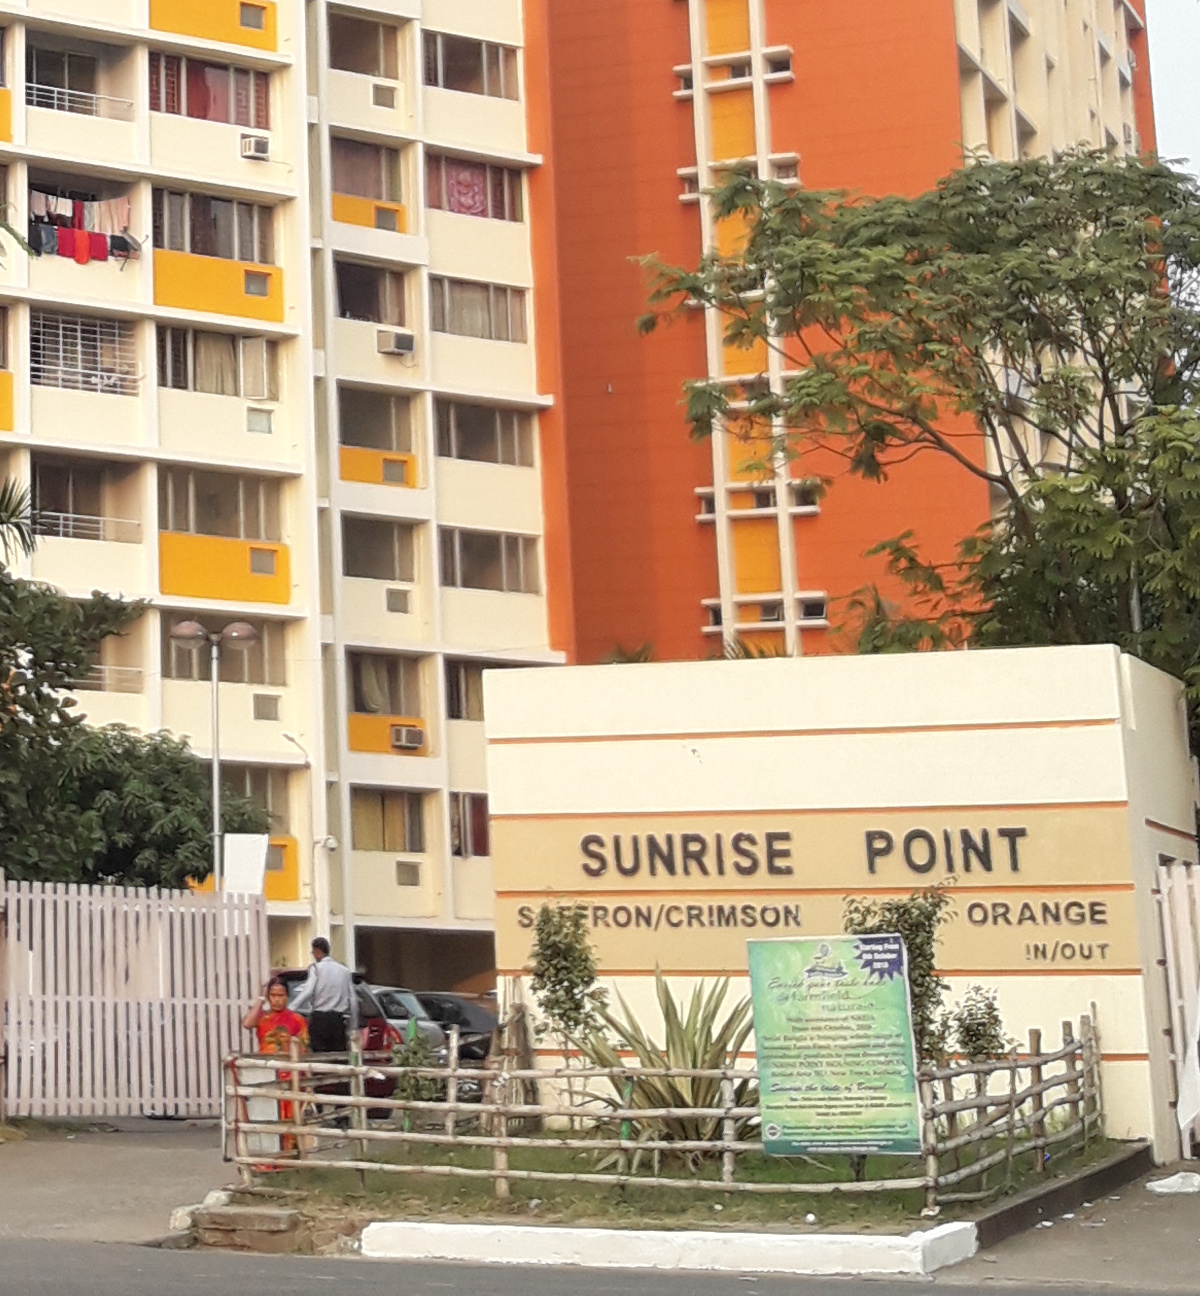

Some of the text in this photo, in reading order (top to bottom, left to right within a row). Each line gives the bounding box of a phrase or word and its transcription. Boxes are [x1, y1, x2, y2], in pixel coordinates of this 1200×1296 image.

[580, 827, 1028, 877] SUNRISE POINT
[967, 901, 1109, 926] ORANGE
[1026, 942, 1110, 962] IN/OUT
